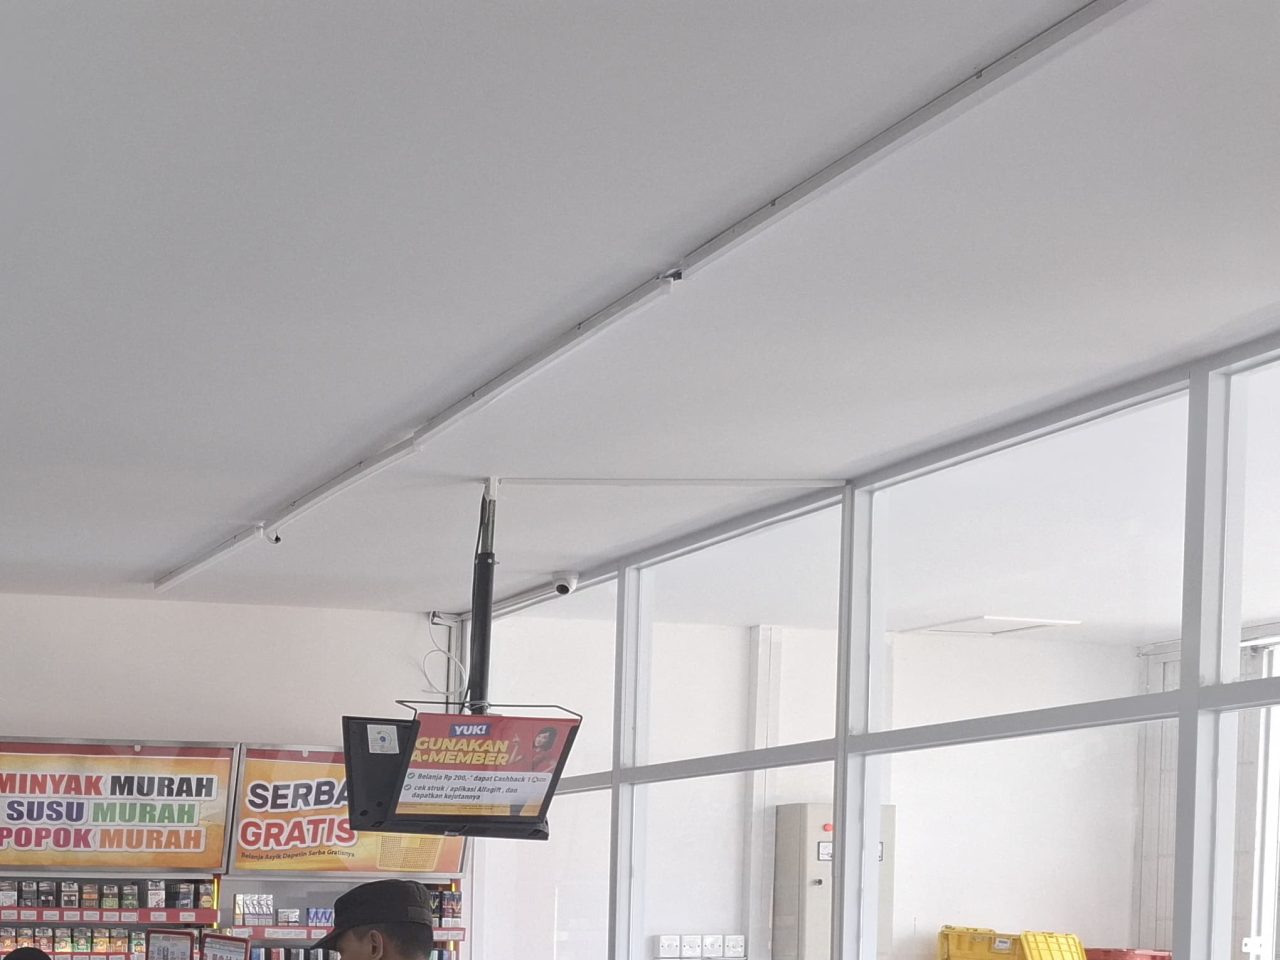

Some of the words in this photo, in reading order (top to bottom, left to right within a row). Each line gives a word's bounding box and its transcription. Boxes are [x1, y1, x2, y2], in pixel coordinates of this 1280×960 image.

[453, 724, 487, 736] YUK!
[414, 737, 509, 753] GUNAKAN
[109, 775, 216, 799] MURAH
[493, 775, 525, 783] Cashback
[247, 780, 348, 810] SERBA
[6, 799, 85, 823] SUSU
[92, 802, 197, 825] MURAH
[98, 828, 203, 850] MURAH
[240, 817, 355, 847] GRATIS
